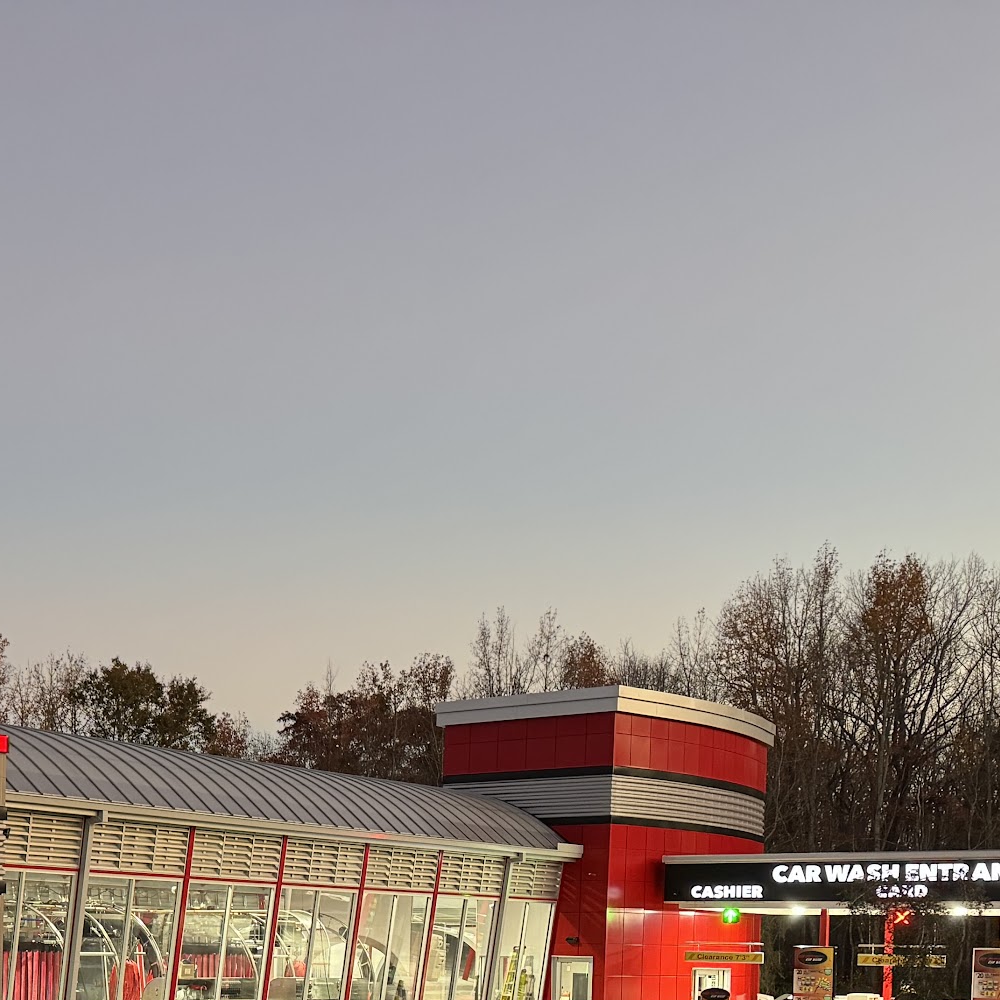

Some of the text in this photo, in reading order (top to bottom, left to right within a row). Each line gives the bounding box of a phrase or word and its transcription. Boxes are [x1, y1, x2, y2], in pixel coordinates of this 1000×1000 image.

[772, 864, 822, 883] CAR
[824, 863, 900, 882] WASH
[690, 885, 764, 899] CASHIER
[697, 953, 733, 961] Clearance
